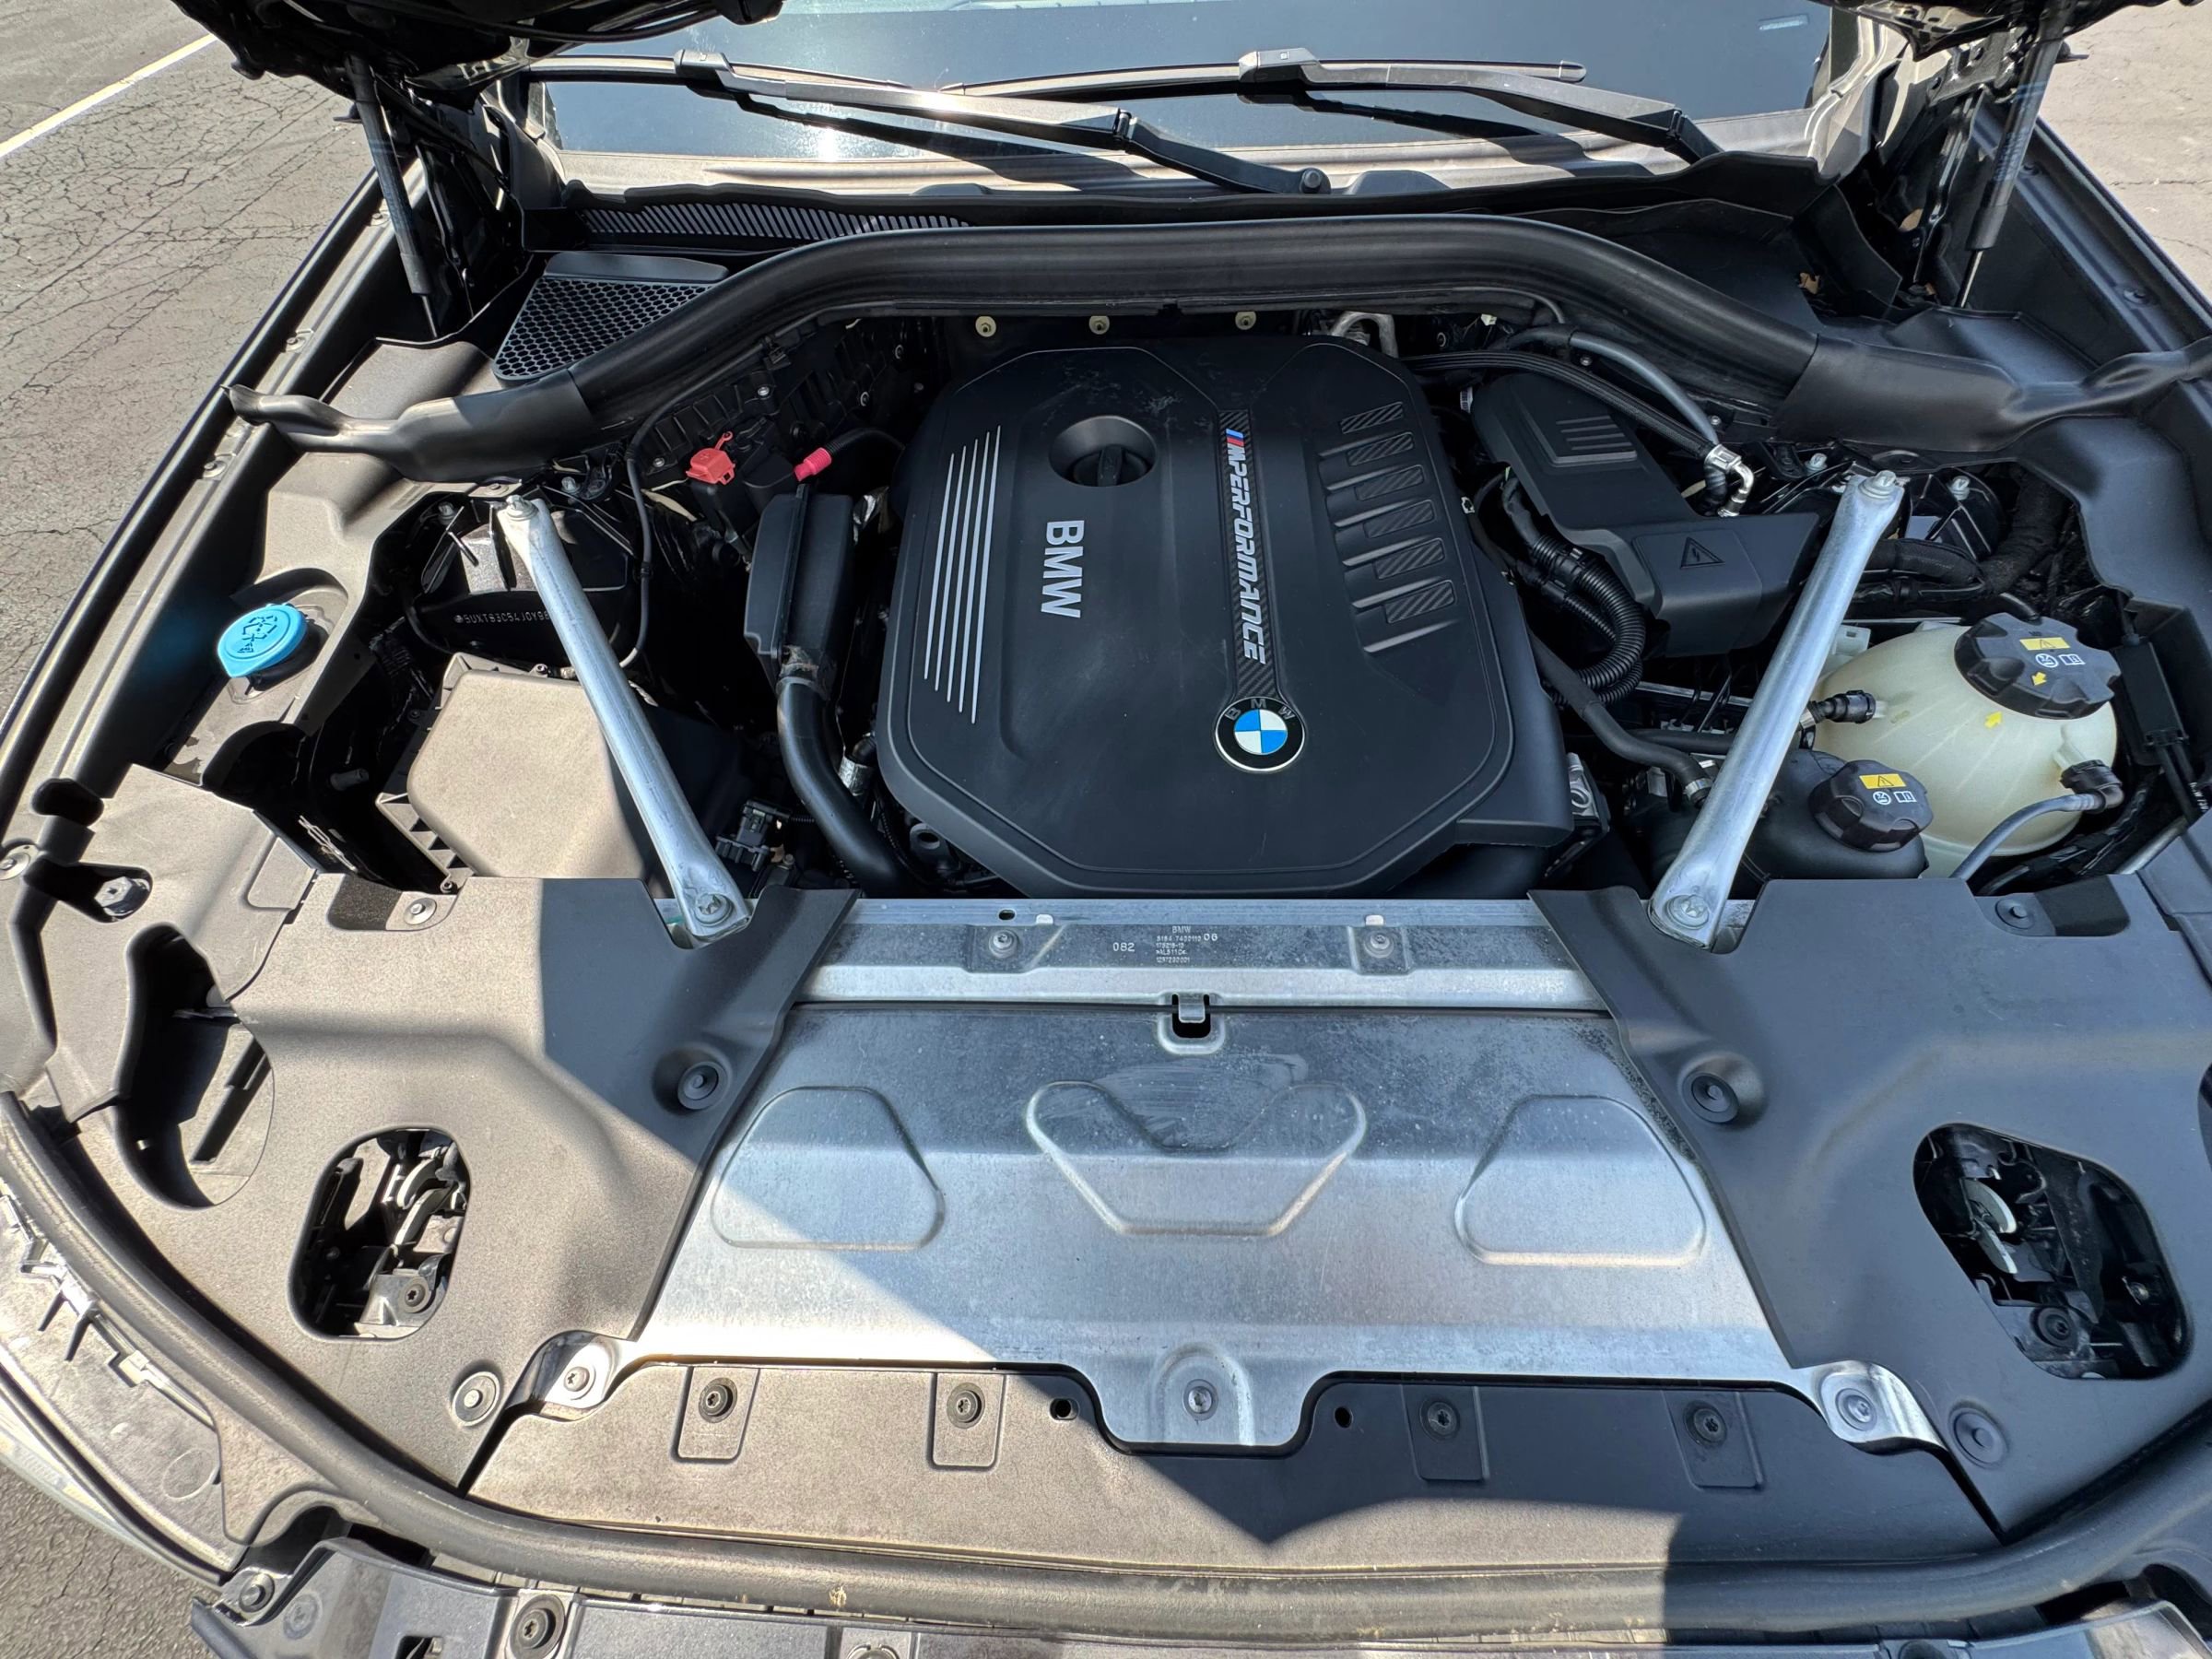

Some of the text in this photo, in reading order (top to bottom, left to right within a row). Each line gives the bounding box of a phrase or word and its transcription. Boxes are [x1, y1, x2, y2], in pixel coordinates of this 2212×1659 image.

[1041, 520, 1085, 618] BMW
[1223, 698, 1296, 721] BMW
[1171, 925, 1191, 934] BMW
[1112, 942, 1135, 952] 082
